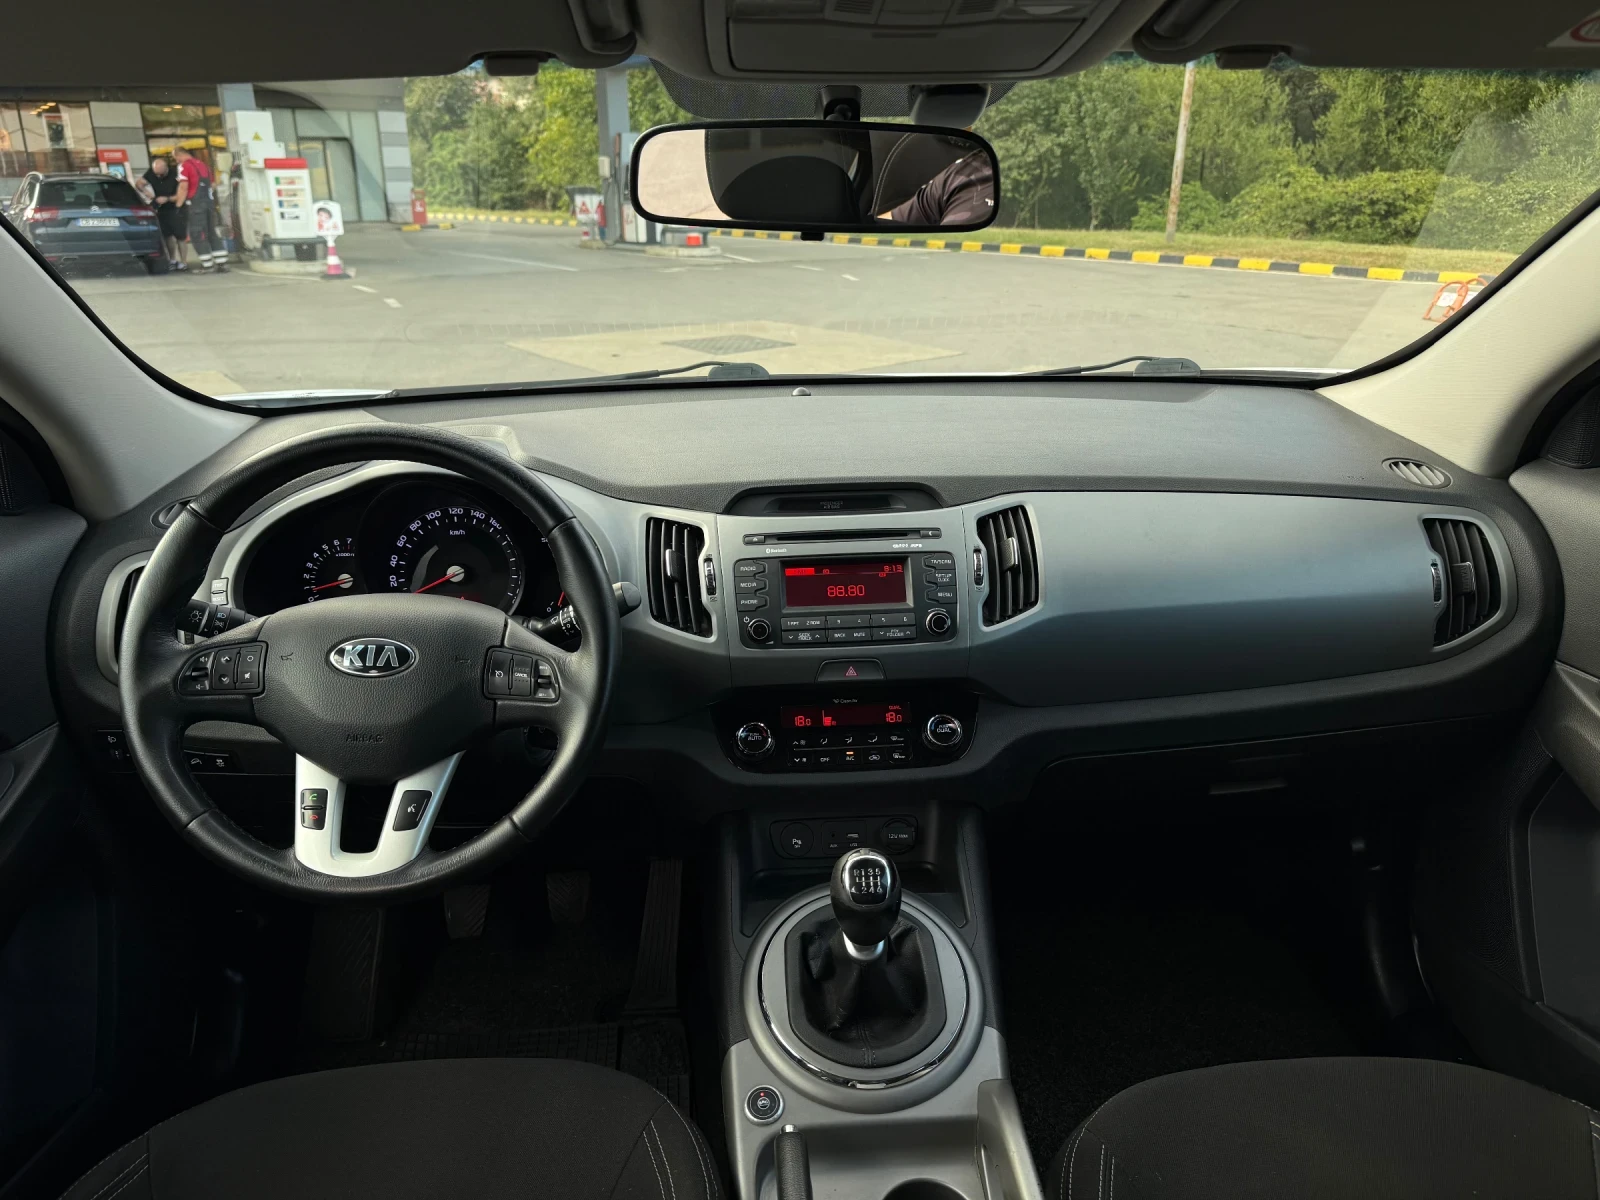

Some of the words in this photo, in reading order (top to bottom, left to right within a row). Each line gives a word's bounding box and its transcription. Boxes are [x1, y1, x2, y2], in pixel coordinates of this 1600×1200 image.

[425, 510, 441, 520] 100
[470, 510, 486, 520] 140
[409, 520, 422, 531] 80
[396, 535, 407, 547] 60
[321, 543, 329, 551] 5
[389, 554, 398, 567] 40
[389, 575, 397, 587] 20
[827, 585, 865, 597] 88.80
[343, 645, 399, 667] KIA
[860, 868, 865, 876] 1
[867, 868, 874, 876] 3
[861, 886, 867, 894] 2
